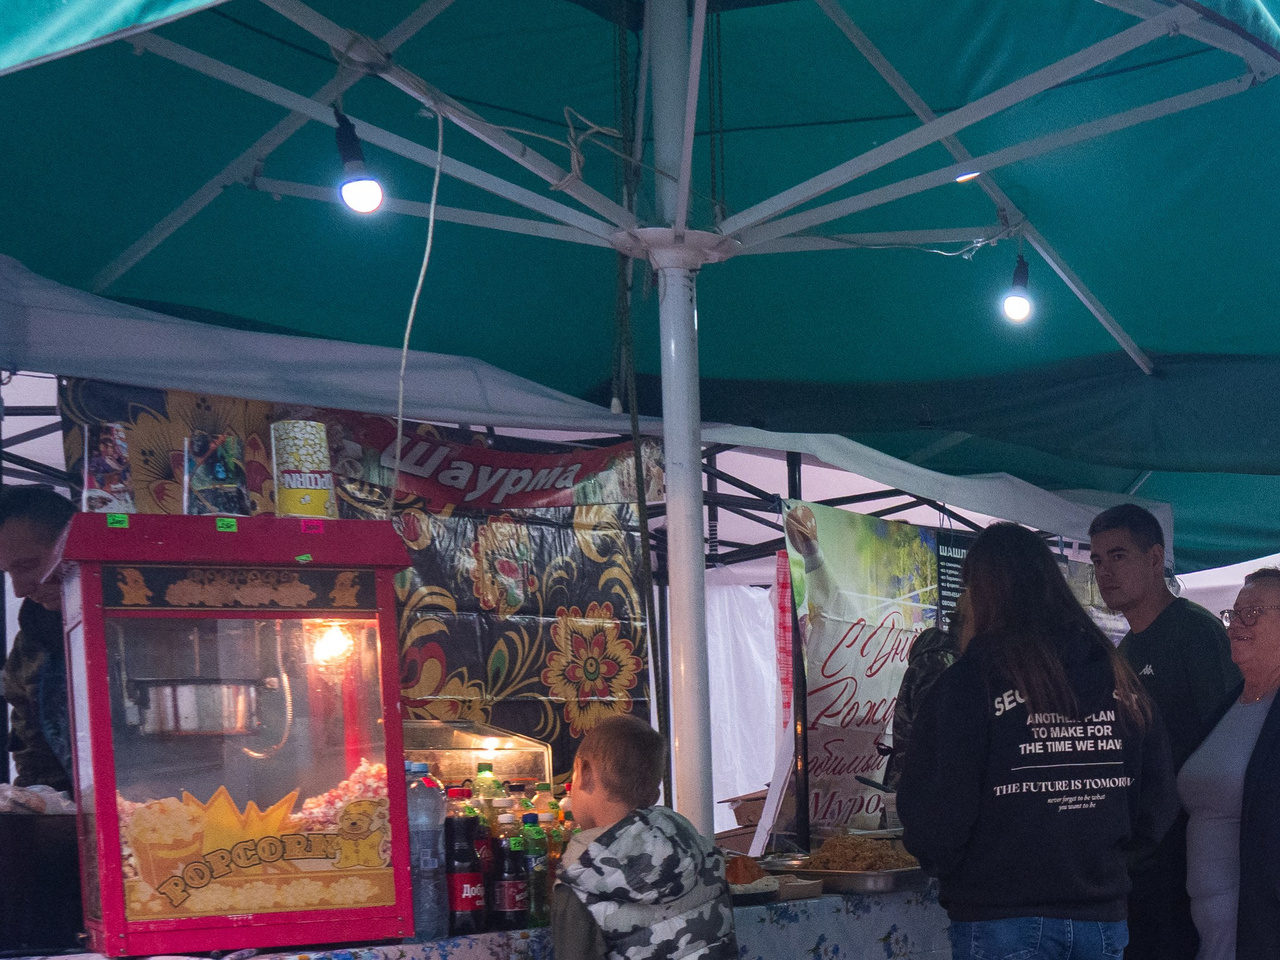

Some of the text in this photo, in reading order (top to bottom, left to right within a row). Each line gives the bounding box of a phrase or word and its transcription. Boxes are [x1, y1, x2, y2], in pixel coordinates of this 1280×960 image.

[380, 436, 582, 503] Шаурма
[939, 545, 967, 559] ШАШЛ
[1026, 712, 1081, 725] ANOTH
[1032, 724, 1113, 739] TO MAKE FOR
[1019, 738, 1123, 755] THE TIME WE HAV
[994, 782, 1020, 796] THE
[1022, 780, 1069, 793] FUTURE
[1071, 779, 1082, 790] IS
[812, 791, 884, 827] Муро
[156, 833, 339, 908] POPCORN
